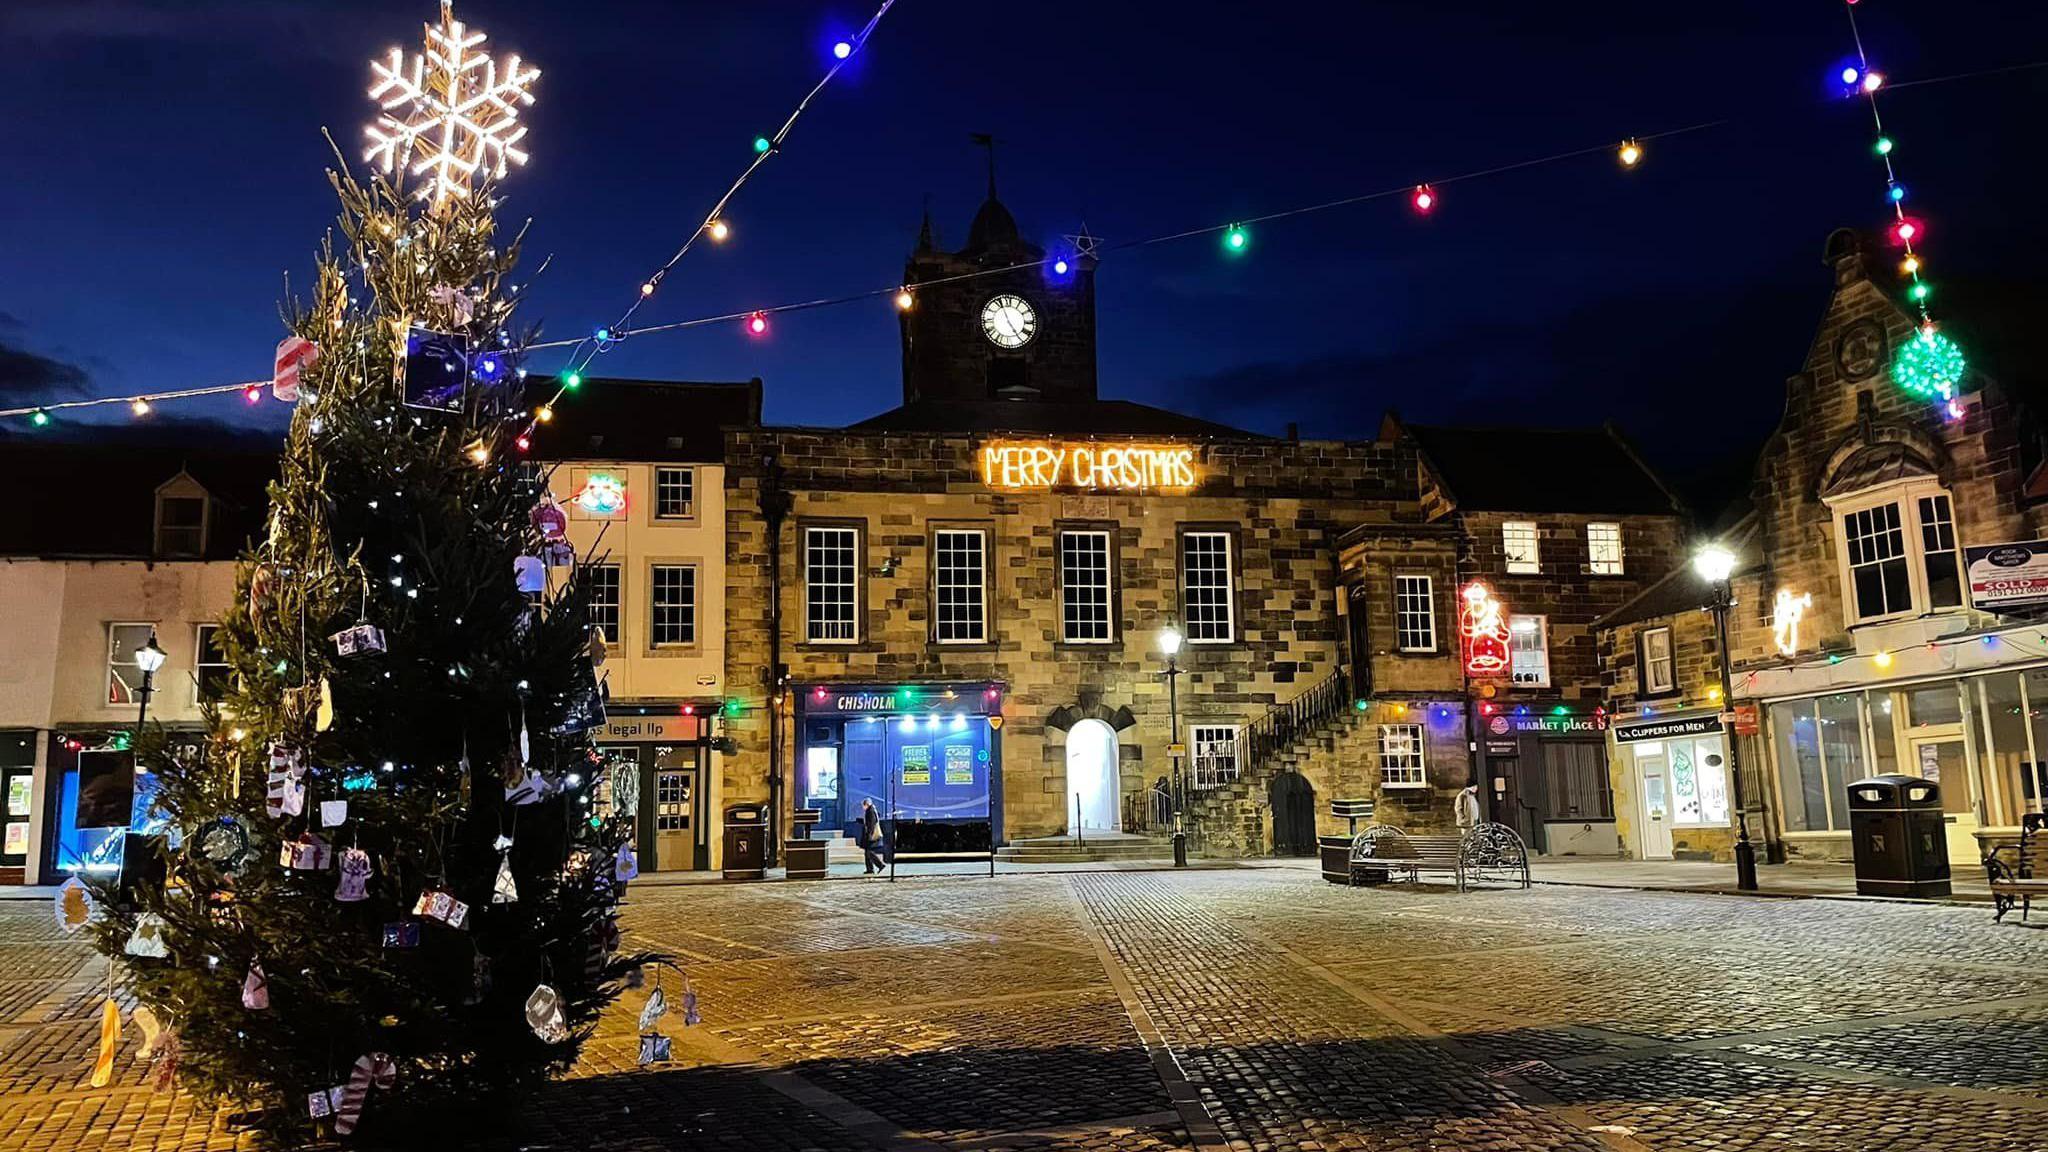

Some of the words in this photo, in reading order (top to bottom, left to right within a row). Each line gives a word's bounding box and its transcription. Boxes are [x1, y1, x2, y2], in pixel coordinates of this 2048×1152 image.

[985, 447, 1066, 487] MERRY
[1073, 448, 1194, 487] CHRISTMAS
[1984, 580, 2032, 590] SOLD
[838, 696, 895, 710] CHISHOLM
[608, 722, 641, 737] legal
[647, 722, 664, 737] llp
